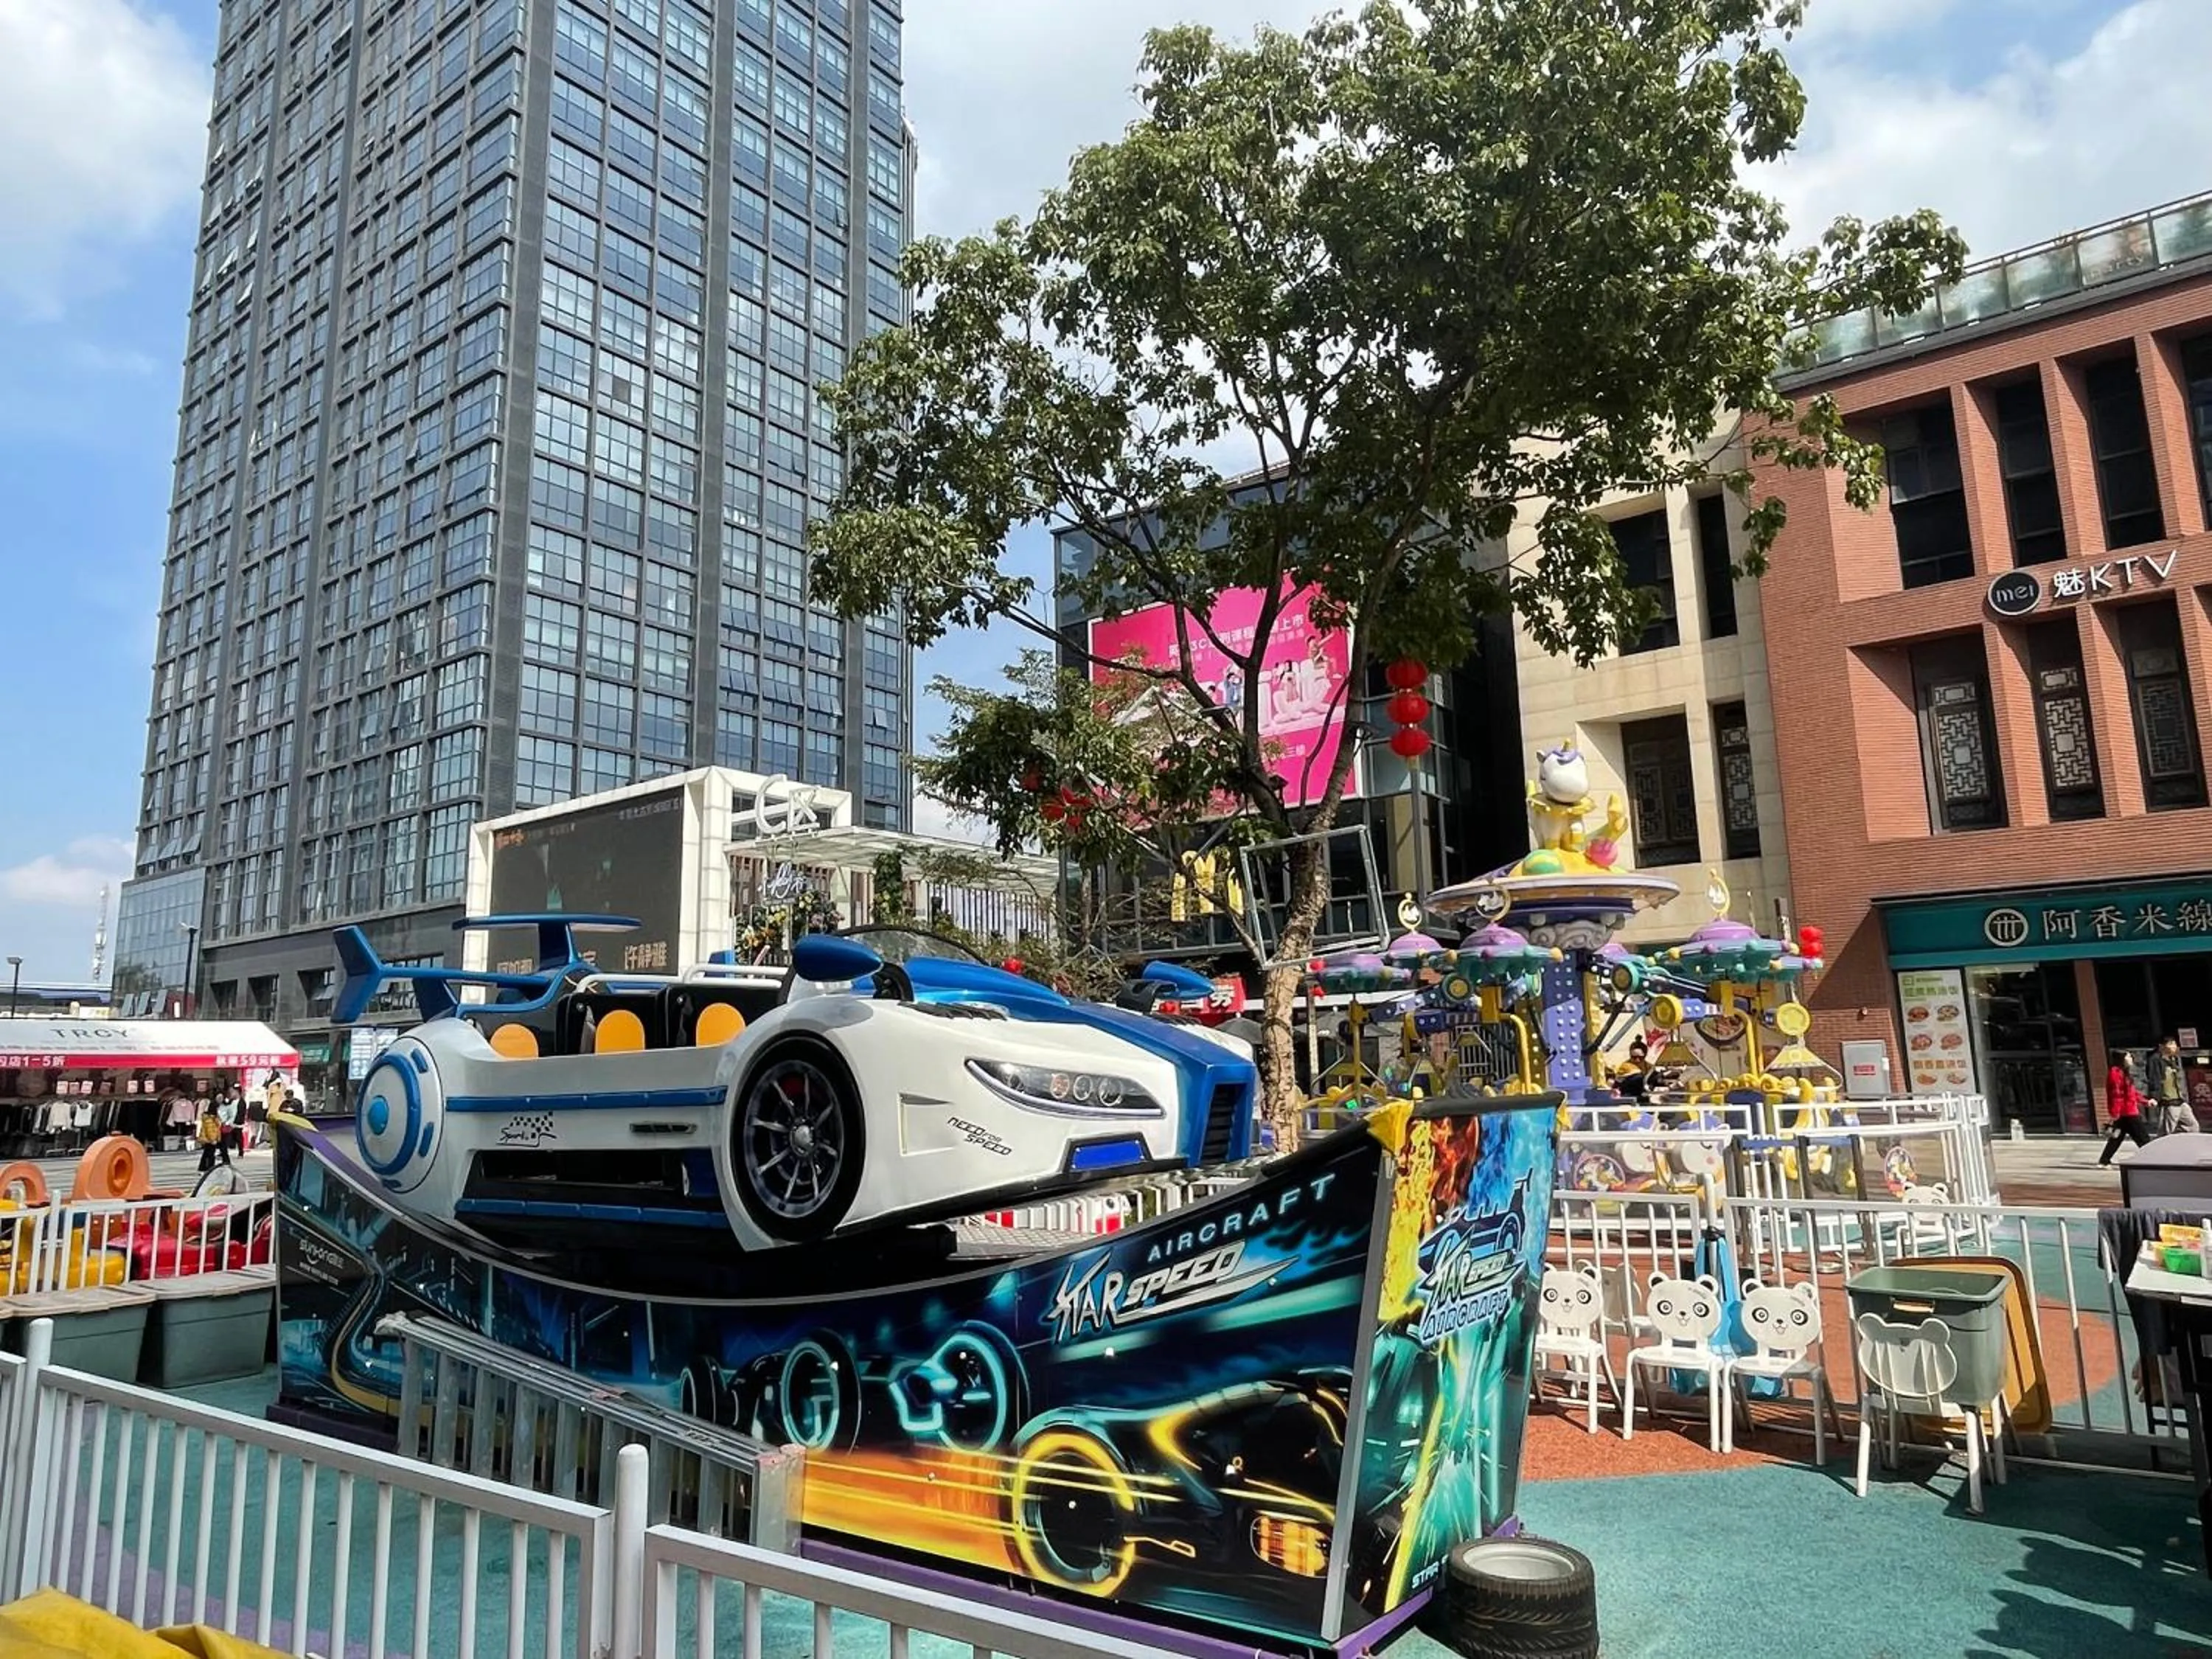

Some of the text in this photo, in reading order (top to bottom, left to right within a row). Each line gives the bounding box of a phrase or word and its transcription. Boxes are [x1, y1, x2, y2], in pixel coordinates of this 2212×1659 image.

[2053, 549, 2177, 599] 魅KTV
[1147, 1173, 1336, 1263] AIRCRAFT
[1048, 1240, 1245, 1344] STAR SPEED
[1426, 1226, 1472, 1309] STAR
[1424, 1290, 1509, 1340] AIRCRAFT
